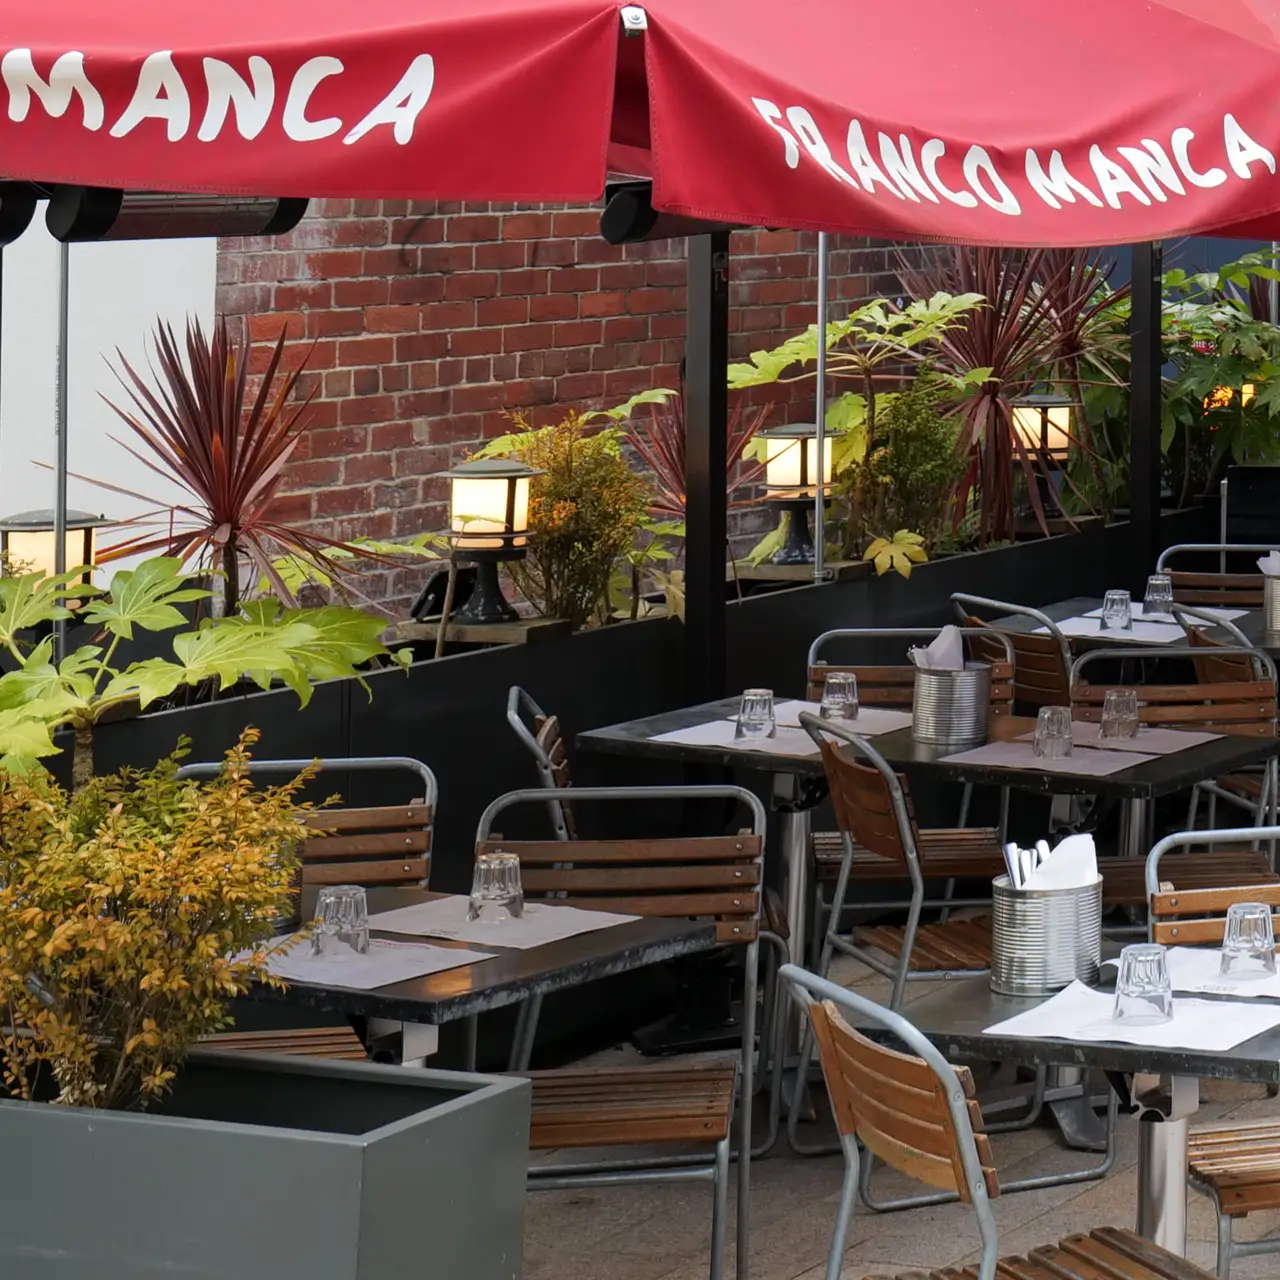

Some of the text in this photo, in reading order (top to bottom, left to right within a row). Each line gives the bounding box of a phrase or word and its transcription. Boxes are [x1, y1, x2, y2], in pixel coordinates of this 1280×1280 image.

[1, 47, 435, 145] MANCA
[751, 96, 1276, 216] FRANCO MANCA
